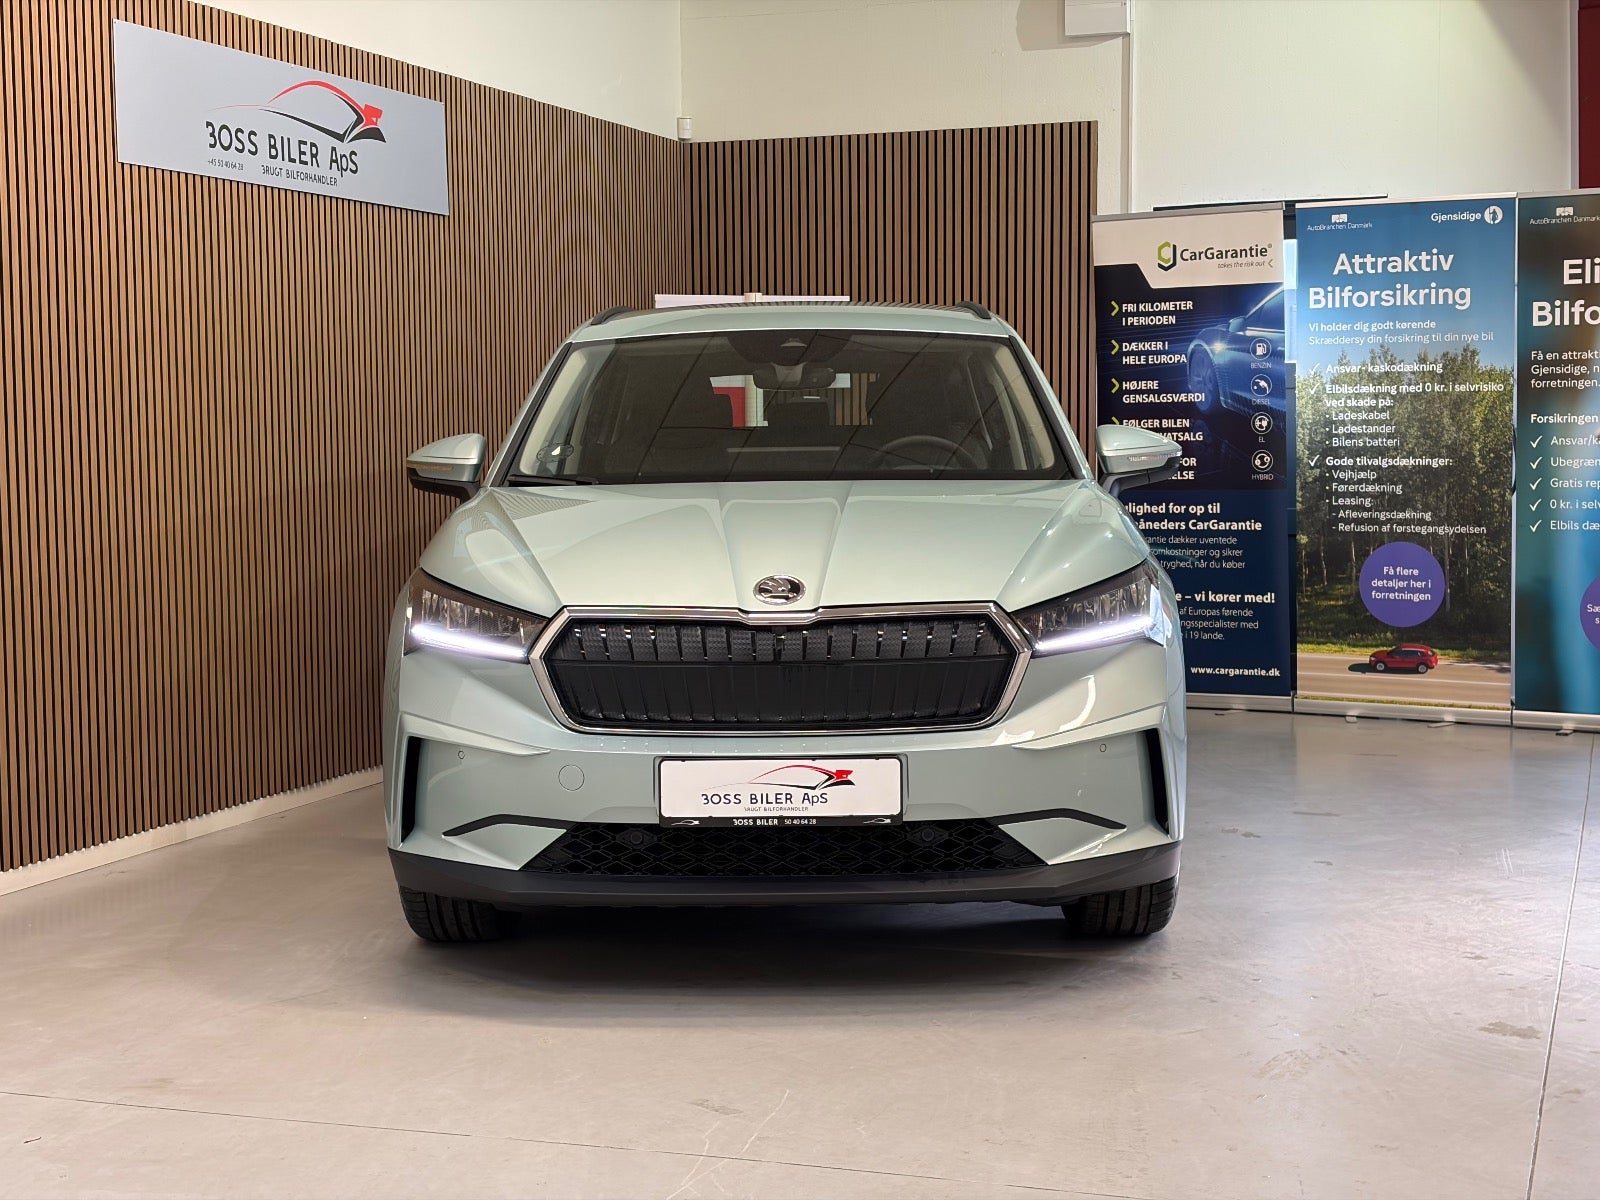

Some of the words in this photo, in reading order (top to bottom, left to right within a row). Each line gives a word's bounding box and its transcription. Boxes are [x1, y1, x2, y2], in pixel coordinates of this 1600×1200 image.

[268, 133, 320, 168] BILER
[329, 146, 358, 177] ApS
[286, 169, 338, 186] BILFORHANDLER
[1431, 211, 1482, 223] Gjensidige
[1348, 222, 1372, 230] Danmark
[1332, 248, 1454, 276] Attraktiv
[1309, 282, 1470, 310] Bilforsikring
[1122, 302, 1137, 312] FRI
[1139, 301, 1193, 312] KILOMETER
[1122, 317, 1126, 326] I
[1128, 316, 1176, 326] PERIODEN
[1309, 322, 1319, 332] Vi
[1321, 322, 1352, 331] holder
[1354, 321, 1369, 332] dig
[1371, 321, 1394, 332] godt
[1396, 320, 1436, 330] kørende
[1309, 336, 1364, 346] Skræddersy
[1367, 334, 1382, 344] din
[1385, 334, 1430, 344] forsikring
[1432, 332, 1442, 342] til
[1444, 332, 1459, 342] din
[1462, 334, 1479, 343] nye
[1482, 331, 1494, 341] bil
[1122, 342, 1163, 352] DÆKKER
[1165, 341, 1168, 350] I
[1122, 356, 1146, 365] HELE
[1148, 354, 1187, 364] EUROPA
[1532, 350, 1543, 360] Få
[1546, 352, 1559, 360] en
[1562, 350, 1600, 360] attrakt
[1368, 363, 1443, 374] kaskodækning
[1531, 364, 1590, 376] Gjensidige,
[1122, 380, 1159, 390] HØJERE
[1326, 384, 1397, 395] Elbilsdækning
[1399, 383, 1422, 393] med
[1425, 383, 1432, 392] 0
[1434, 382, 1447, 392] kr.
[1455, 382, 1504, 392] selvrisiko
[1122, 393, 1205, 404] GENSALGSVÆRDI
[1326, 398, 1345, 407] ved
[1347, 397, 1376, 406] skade
[1332, 411, 1390, 421] Ladeskabel
[1530, 413, 1599, 425] Forsikringen
[1123, 419, 1160, 428] FØLGER
[1162, 419, 1190, 428] BILEN
[1332, 424, 1395, 434] Ladestander
[1332, 437, 1364, 447] Bilens
[1366, 437, 1400, 446] batteri
[1326, 457, 1354, 466] Gode
[1356, 456, 1452, 468] tilvalgsdækninger:
[1332, 470, 1377, 481] Vejhjælp
[1332, 483, 1402, 494] Førerdækning
[1550, 478, 1583, 488] Gratis
[1126, 502, 1166, 515] lighed
[1169, 502, 1186, 513] for
[1189, 505, 1205, 516] op
[1208, 503, 1220, 514] til
[1550, 499, 1557, 509] 0
[1560, 499, 1573, 509] kr.
[1338, 510, 1431, 521] Afleveringsdækning
[1137, 519, 1186, 530] åneders
[1189, 520, 1262, 531] CarGarantie
[1338, 523, 1379, 533] Refusion
[1382, 524, 1390, 533] af
[1393, 524, 1486, 535] førstegangsydelsen
[1550, 520, 1579, 530] Elbils
[1169, 535, 1197, 544] dækker
[1200, 536, 1238, 545] uventede
[1209, 550, 1219, 558] og
[1222, 548, 1243, 557] sikrer
[1160, 560, 1193, 569] tryghed,
[1195, 559, 1208, 568] når
[1210, 560, 1220, 569] du
[1222, 560, 1246, 569] køber
[1384, 566, 1394, 575] Få
[1397, 566, 1419, 576] flere
[1372, 579, 1408, 590] detaljer
[1410, 579, 1426, 588] her
[1194, 591, 1206, 602] vi
[1208, 591, 1242, 602] kører
[1244, 592, 1275, 603] med!
[1372, 591, 1431, 602] forretningen
[1180, 607, 1187, 615] af
[1188, 607, 1220, 617] Europas
[1222, 607, 1253, 617] førende
[1180, 620, 1239, 629] ngsspecialister
[1240, 621, 1259, 629] med
[1190, 631, 1199, 639] 19
[1200, 632, 1225, 640] lande.
[1190, 666, 1281, 677] www.cargarantie.dk
[750, 793, 793, 804] BILER
[802, 792, 828, 806] ApS
